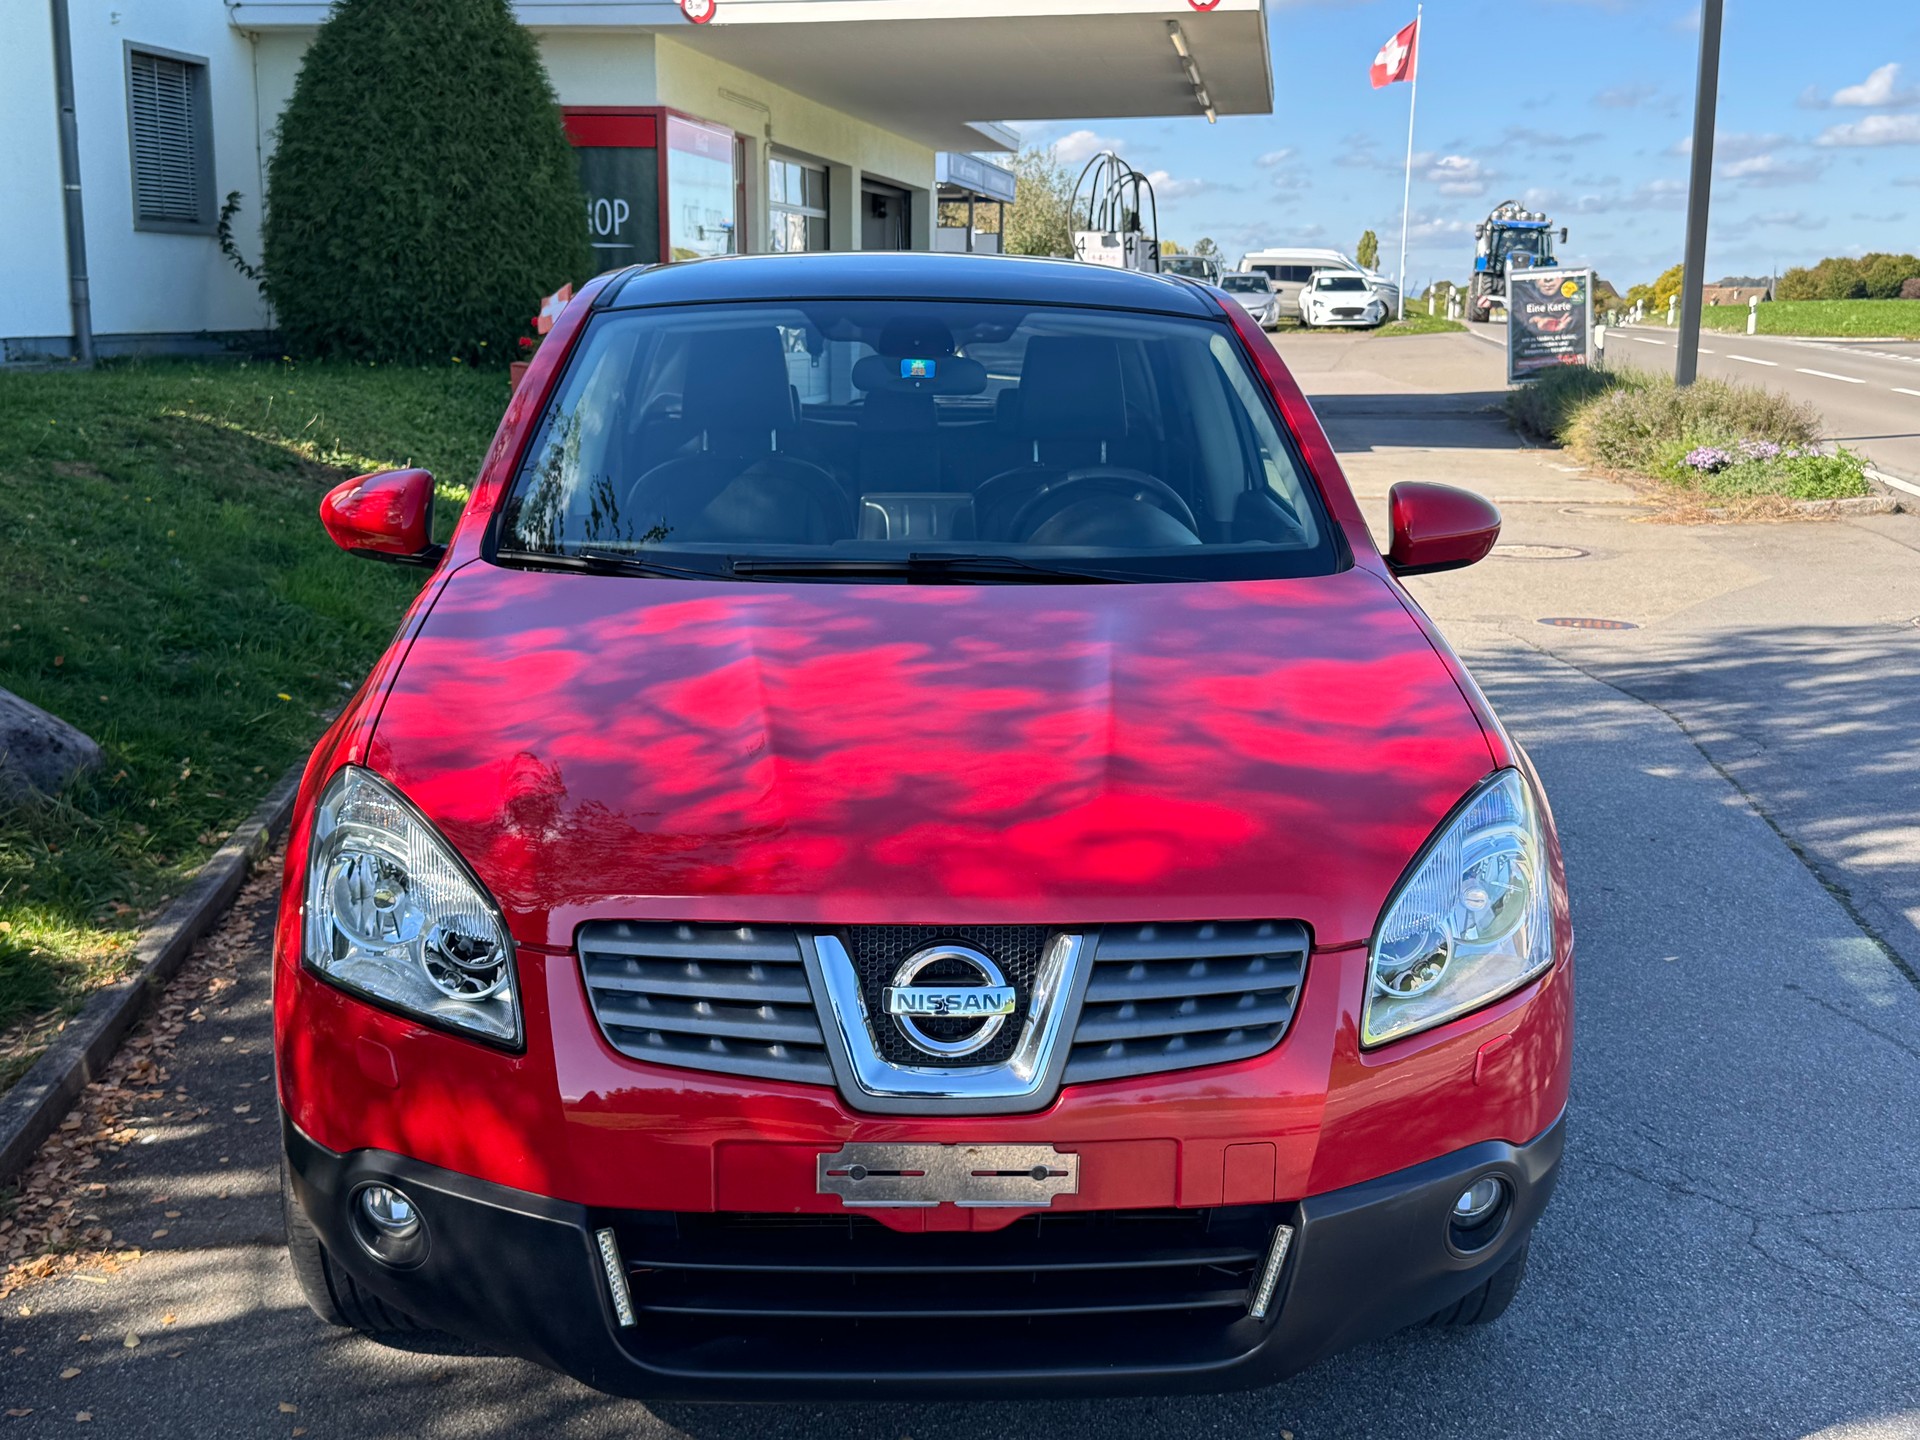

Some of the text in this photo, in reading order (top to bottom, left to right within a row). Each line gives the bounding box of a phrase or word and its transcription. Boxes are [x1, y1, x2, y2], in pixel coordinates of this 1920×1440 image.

[1076, 236, 1086, 254] 4
[1125, 236, 1134, 255] 4
[1148, 244, 1158, 260] 2
[1526, 302, 1572, 313] Eine Karte
[897, 993, 1002, 1010] NISSAN
